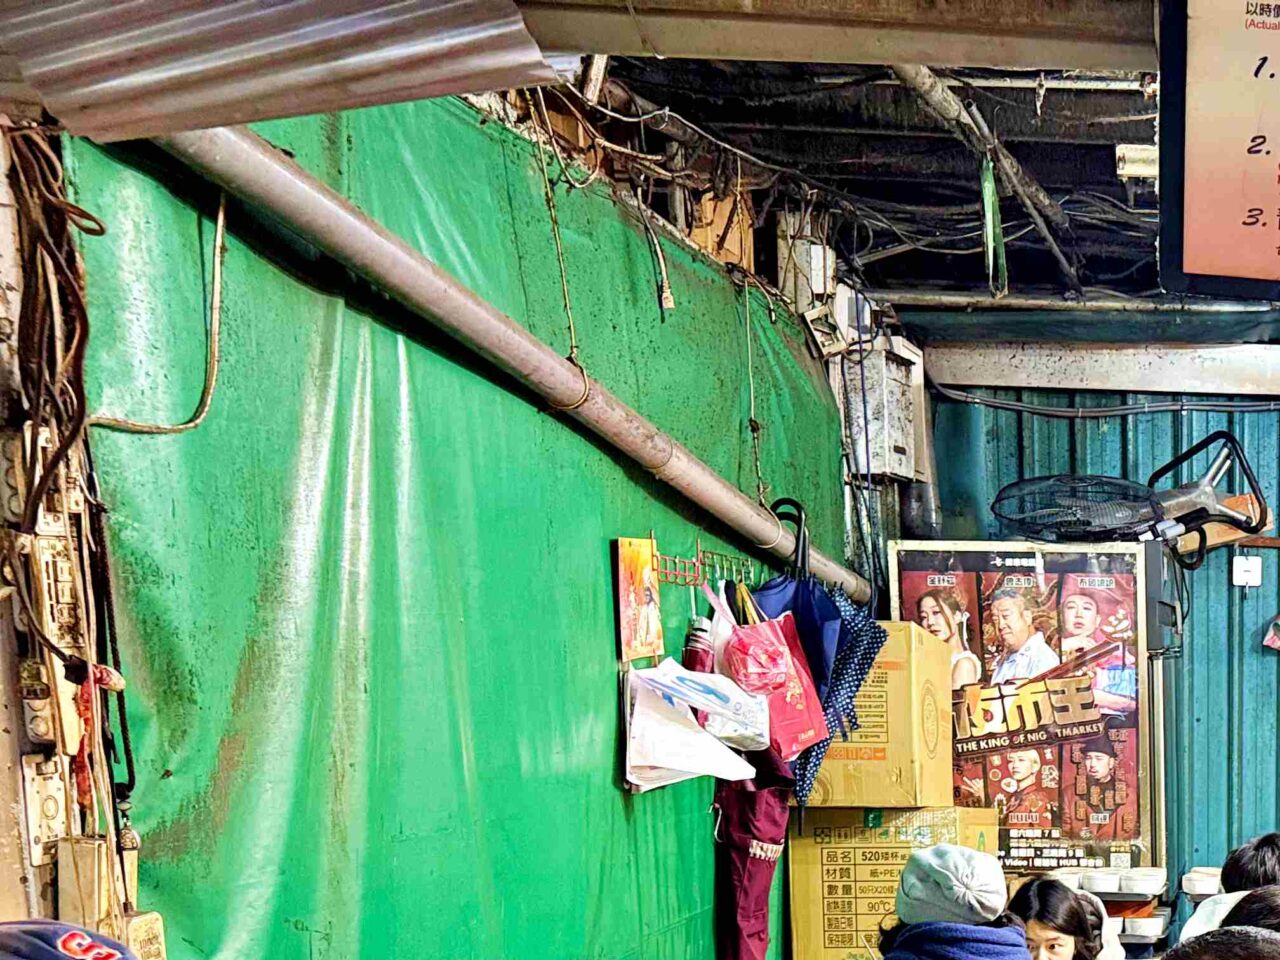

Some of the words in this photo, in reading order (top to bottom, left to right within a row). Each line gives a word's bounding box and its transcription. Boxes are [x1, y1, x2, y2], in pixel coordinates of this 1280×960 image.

[1244, 18, 1280, 30] (Actual
[1254, 56, 1275, 79] 1.
[1246, 135, 1271, 156] 2.
[1242, 208, 1267, 227] 3.
[956, 742, 978, 753] THE
[980, 738, 1009, 749] KING
[1012, 735, 1025, 744] OF
[1027, 723, 1104, 742] NIGTMARKET
[826, 851, 851, 862] 品名
[825, 867, 851, 879] 材質
[827, 884, 852, 895] 數量
